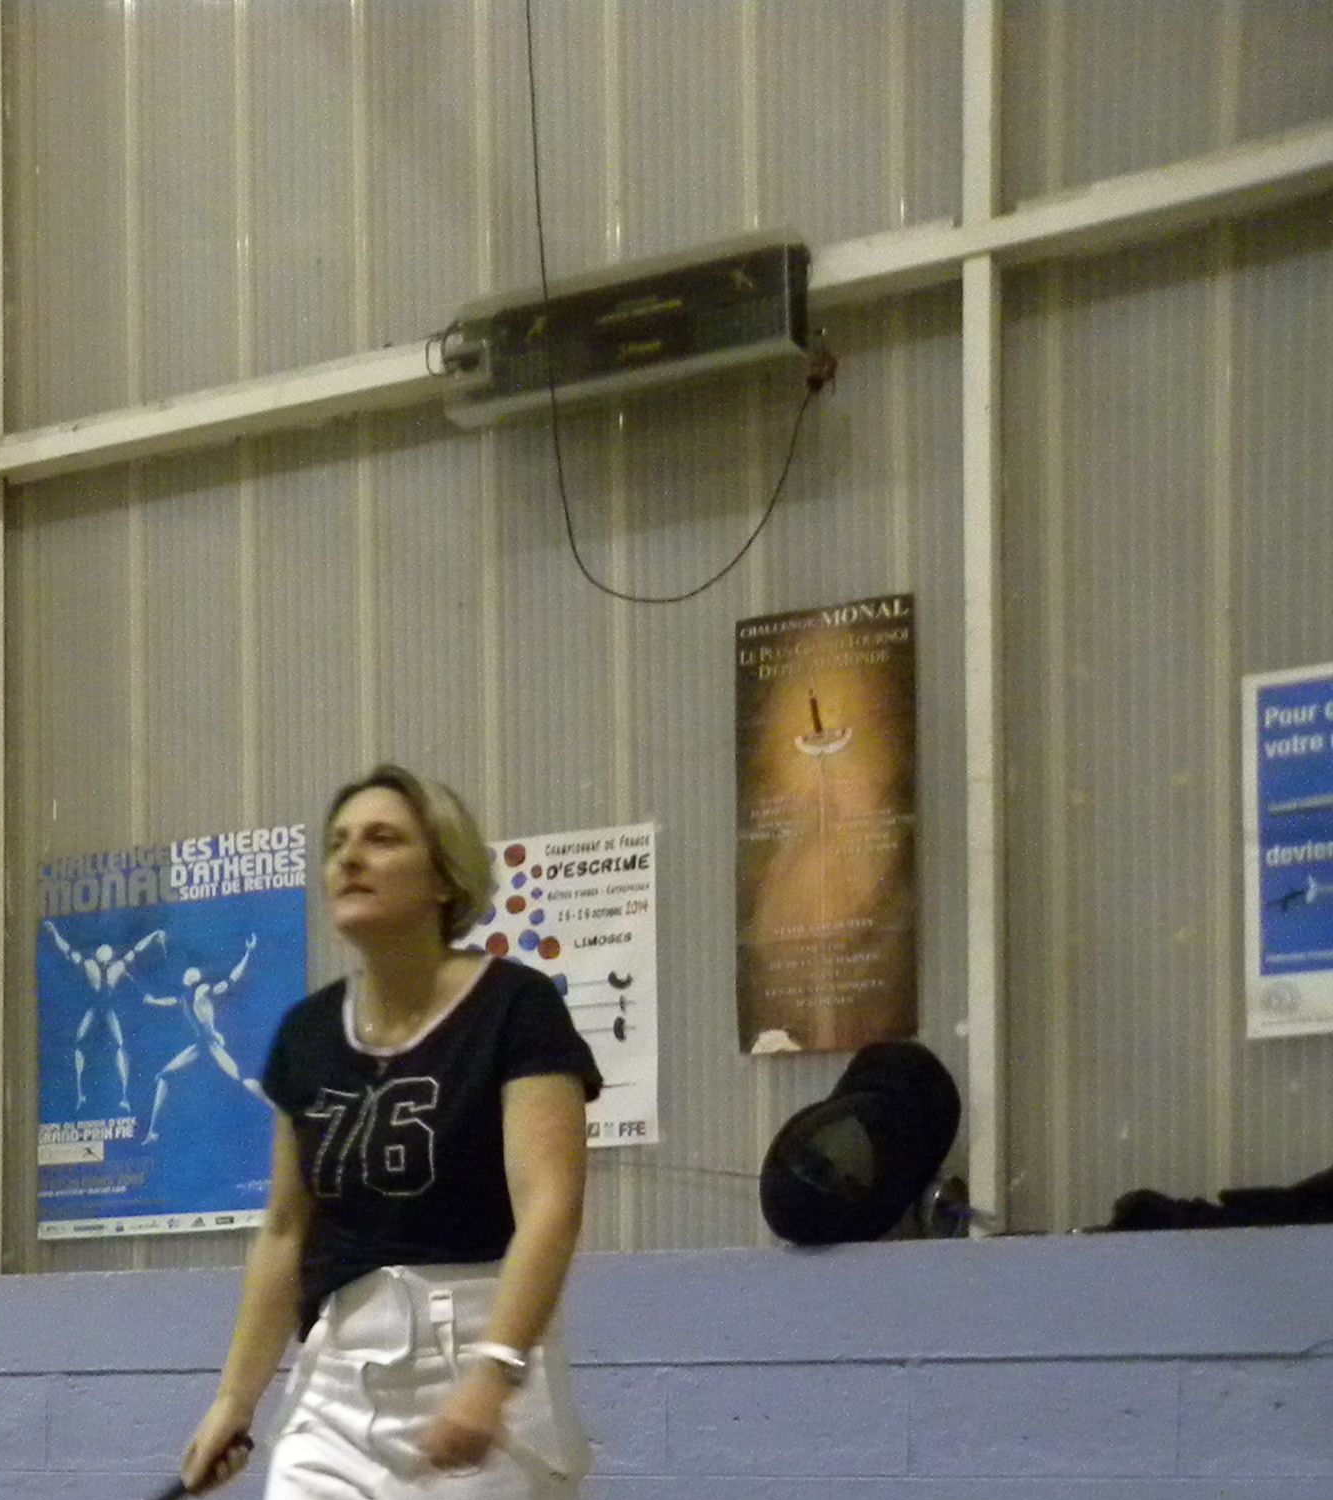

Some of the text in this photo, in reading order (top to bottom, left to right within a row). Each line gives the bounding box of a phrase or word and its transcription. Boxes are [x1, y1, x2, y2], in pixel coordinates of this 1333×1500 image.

[821, 598, 910, 627] MONAL
[1265, 703, 1320, 729] Pour
[1265, 734, 1324, 759] votre
[170, 824, 306, 864] LES HEROS
[170, 850, 306, 888] D'ATHENES
[546, 853, 651, 881] D'ESCRIME
[179, 870, 306, 901] SONT DE RETOUR
[573, 931, 633, 949] LIMOGES
[304, 1076, 440, 1198] 76
[618, 1120, 646, 1138] FFE
